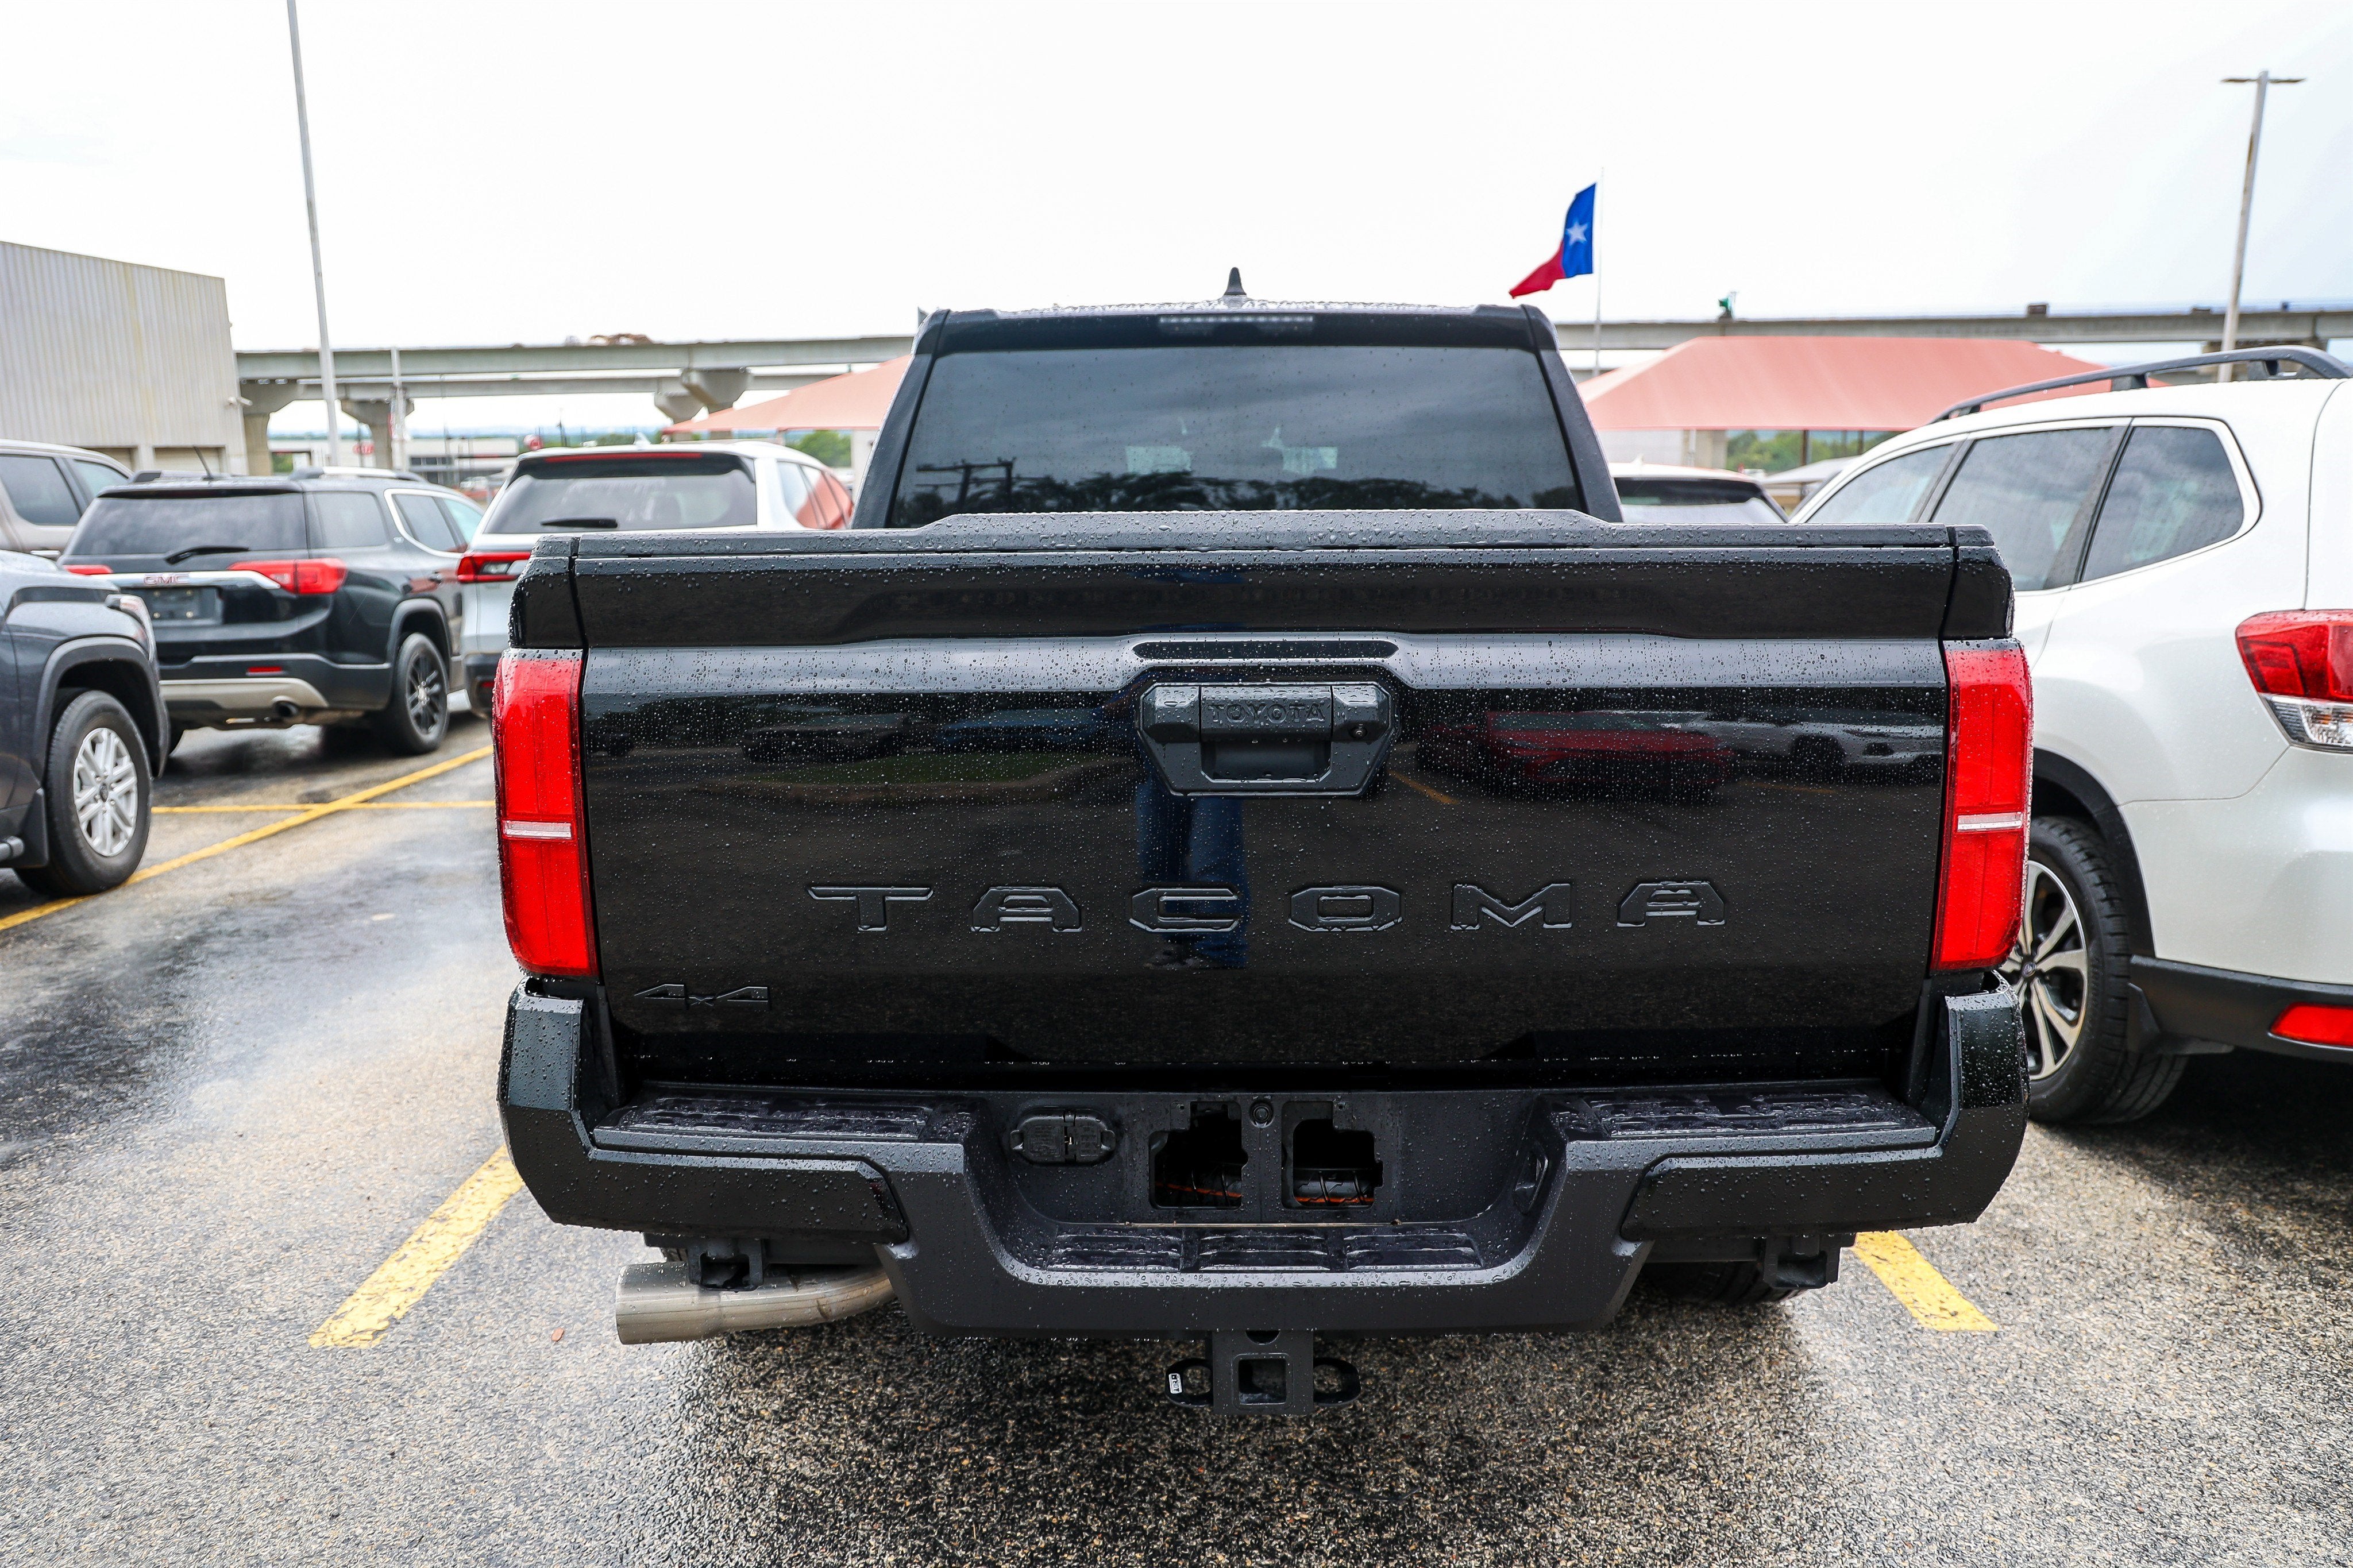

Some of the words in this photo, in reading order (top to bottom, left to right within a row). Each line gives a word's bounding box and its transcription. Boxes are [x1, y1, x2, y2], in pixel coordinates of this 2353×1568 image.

[144, 573, 190, 585] GMC
[1208, 702, 1326, 724] TOYOTA
[808, 879, 1726, 934] TACOMA
